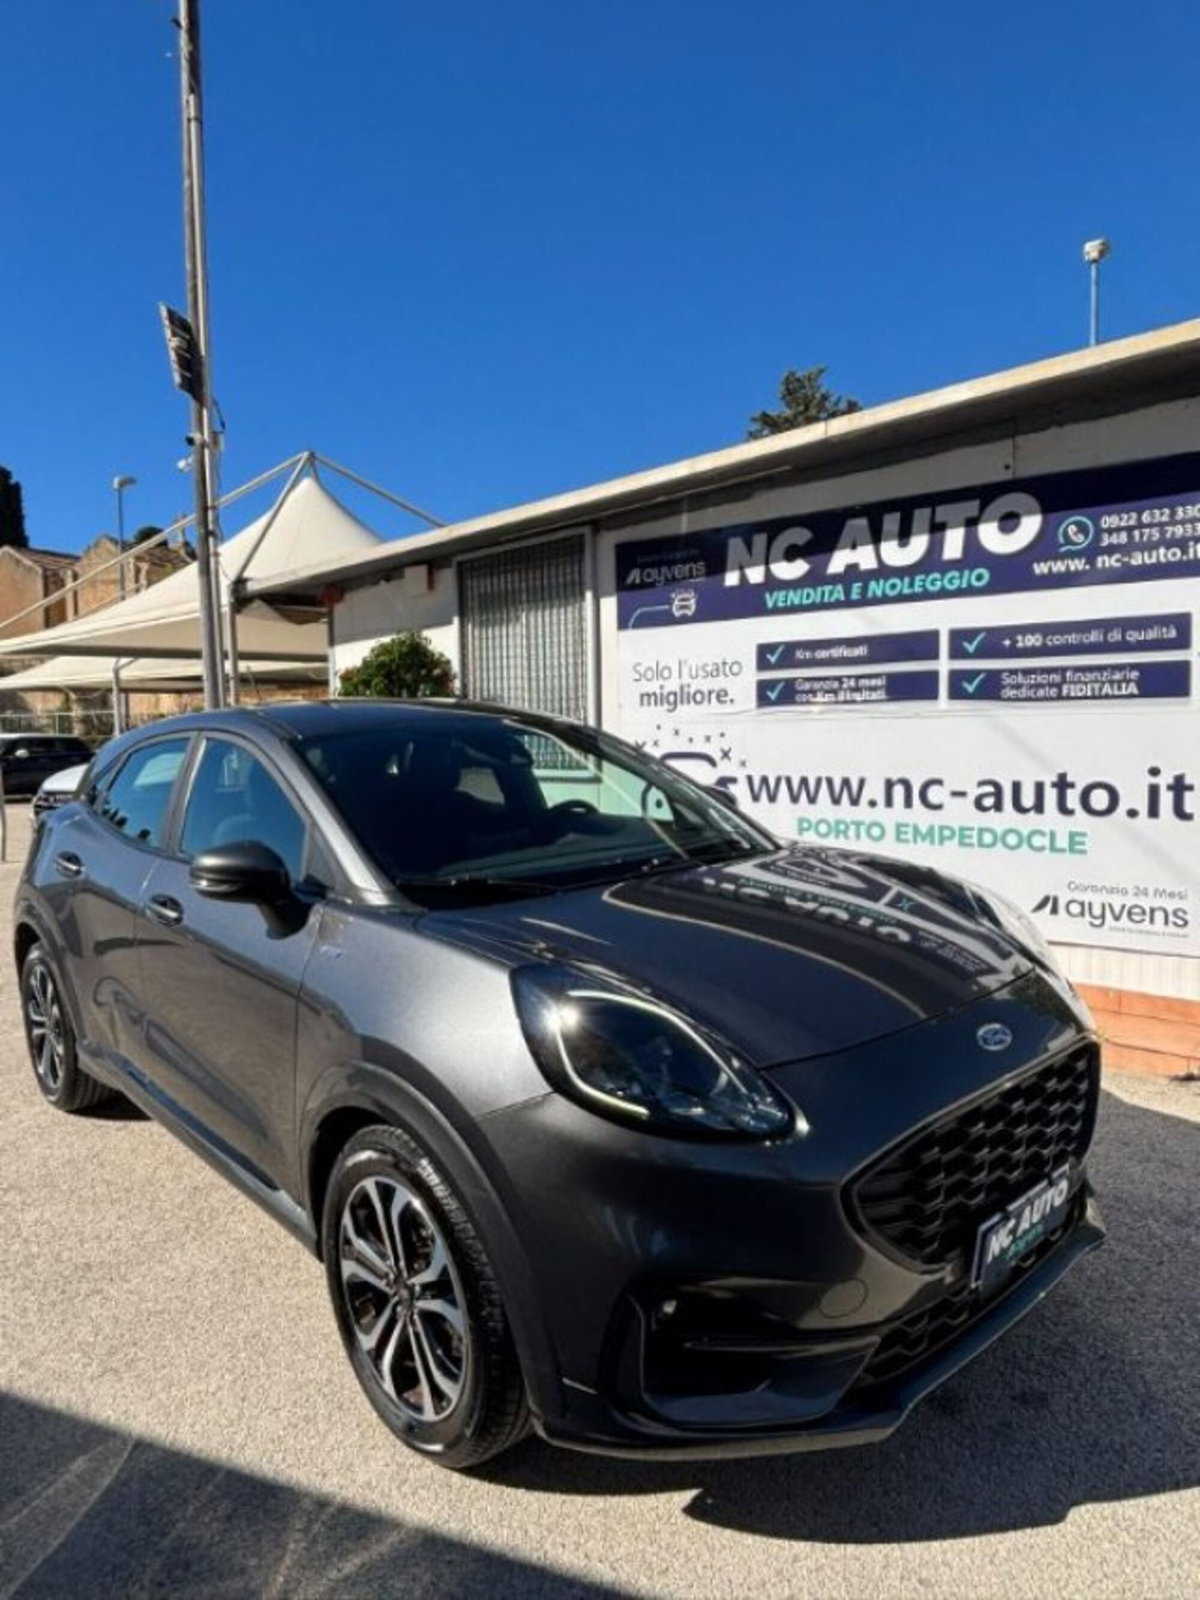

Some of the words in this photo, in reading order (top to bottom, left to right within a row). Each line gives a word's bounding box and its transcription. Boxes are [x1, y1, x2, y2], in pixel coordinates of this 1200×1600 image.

[1101, 512, 1138, 529] 0922
[1142, 508, 1170, 524] 632
[724, 526, 814, 587] NC
[826, 492, 1043, 575] AUTO
[1101, 531, 1128, 547] 348
[1133, 528, 1160, 543] 175
[1033, 558, 1090, 575] www.
[765, 585, 845, 609] VENDITA
[851, 583, 862, 600] E
[867, 568, 990, 599] NOLEGGIO
[1016, 634, 1043, 648] 100
[1046, 628, 1103, 646] controlli
[1107, 626, 1122, 643] di
[1126, 624, 1177, 643] qualità
[632, 659, 672, 682] Solo
[678, 658, 743, 680] l'usato
[1001, 671, 1062, 685] Soluzioni
[1066, 668, 1140, 682] finanziarie
[640, 683, 735, 713] migliore.
[1001, 687, 1058, 700] dedicate
[1062, 682, 1140, 697] FIDITALIA
[746, 766, 1195, 822] www.nc-auto.it
[797, 817, 886, 843] PORTO
[894, 822, 1088, 855] EMPEDOCLE
[1065, 897, 1189, 929] ayvens
[987, 1218, 1017, 1264] NC
[1015, 1179, 1069, 1238] AUTO
